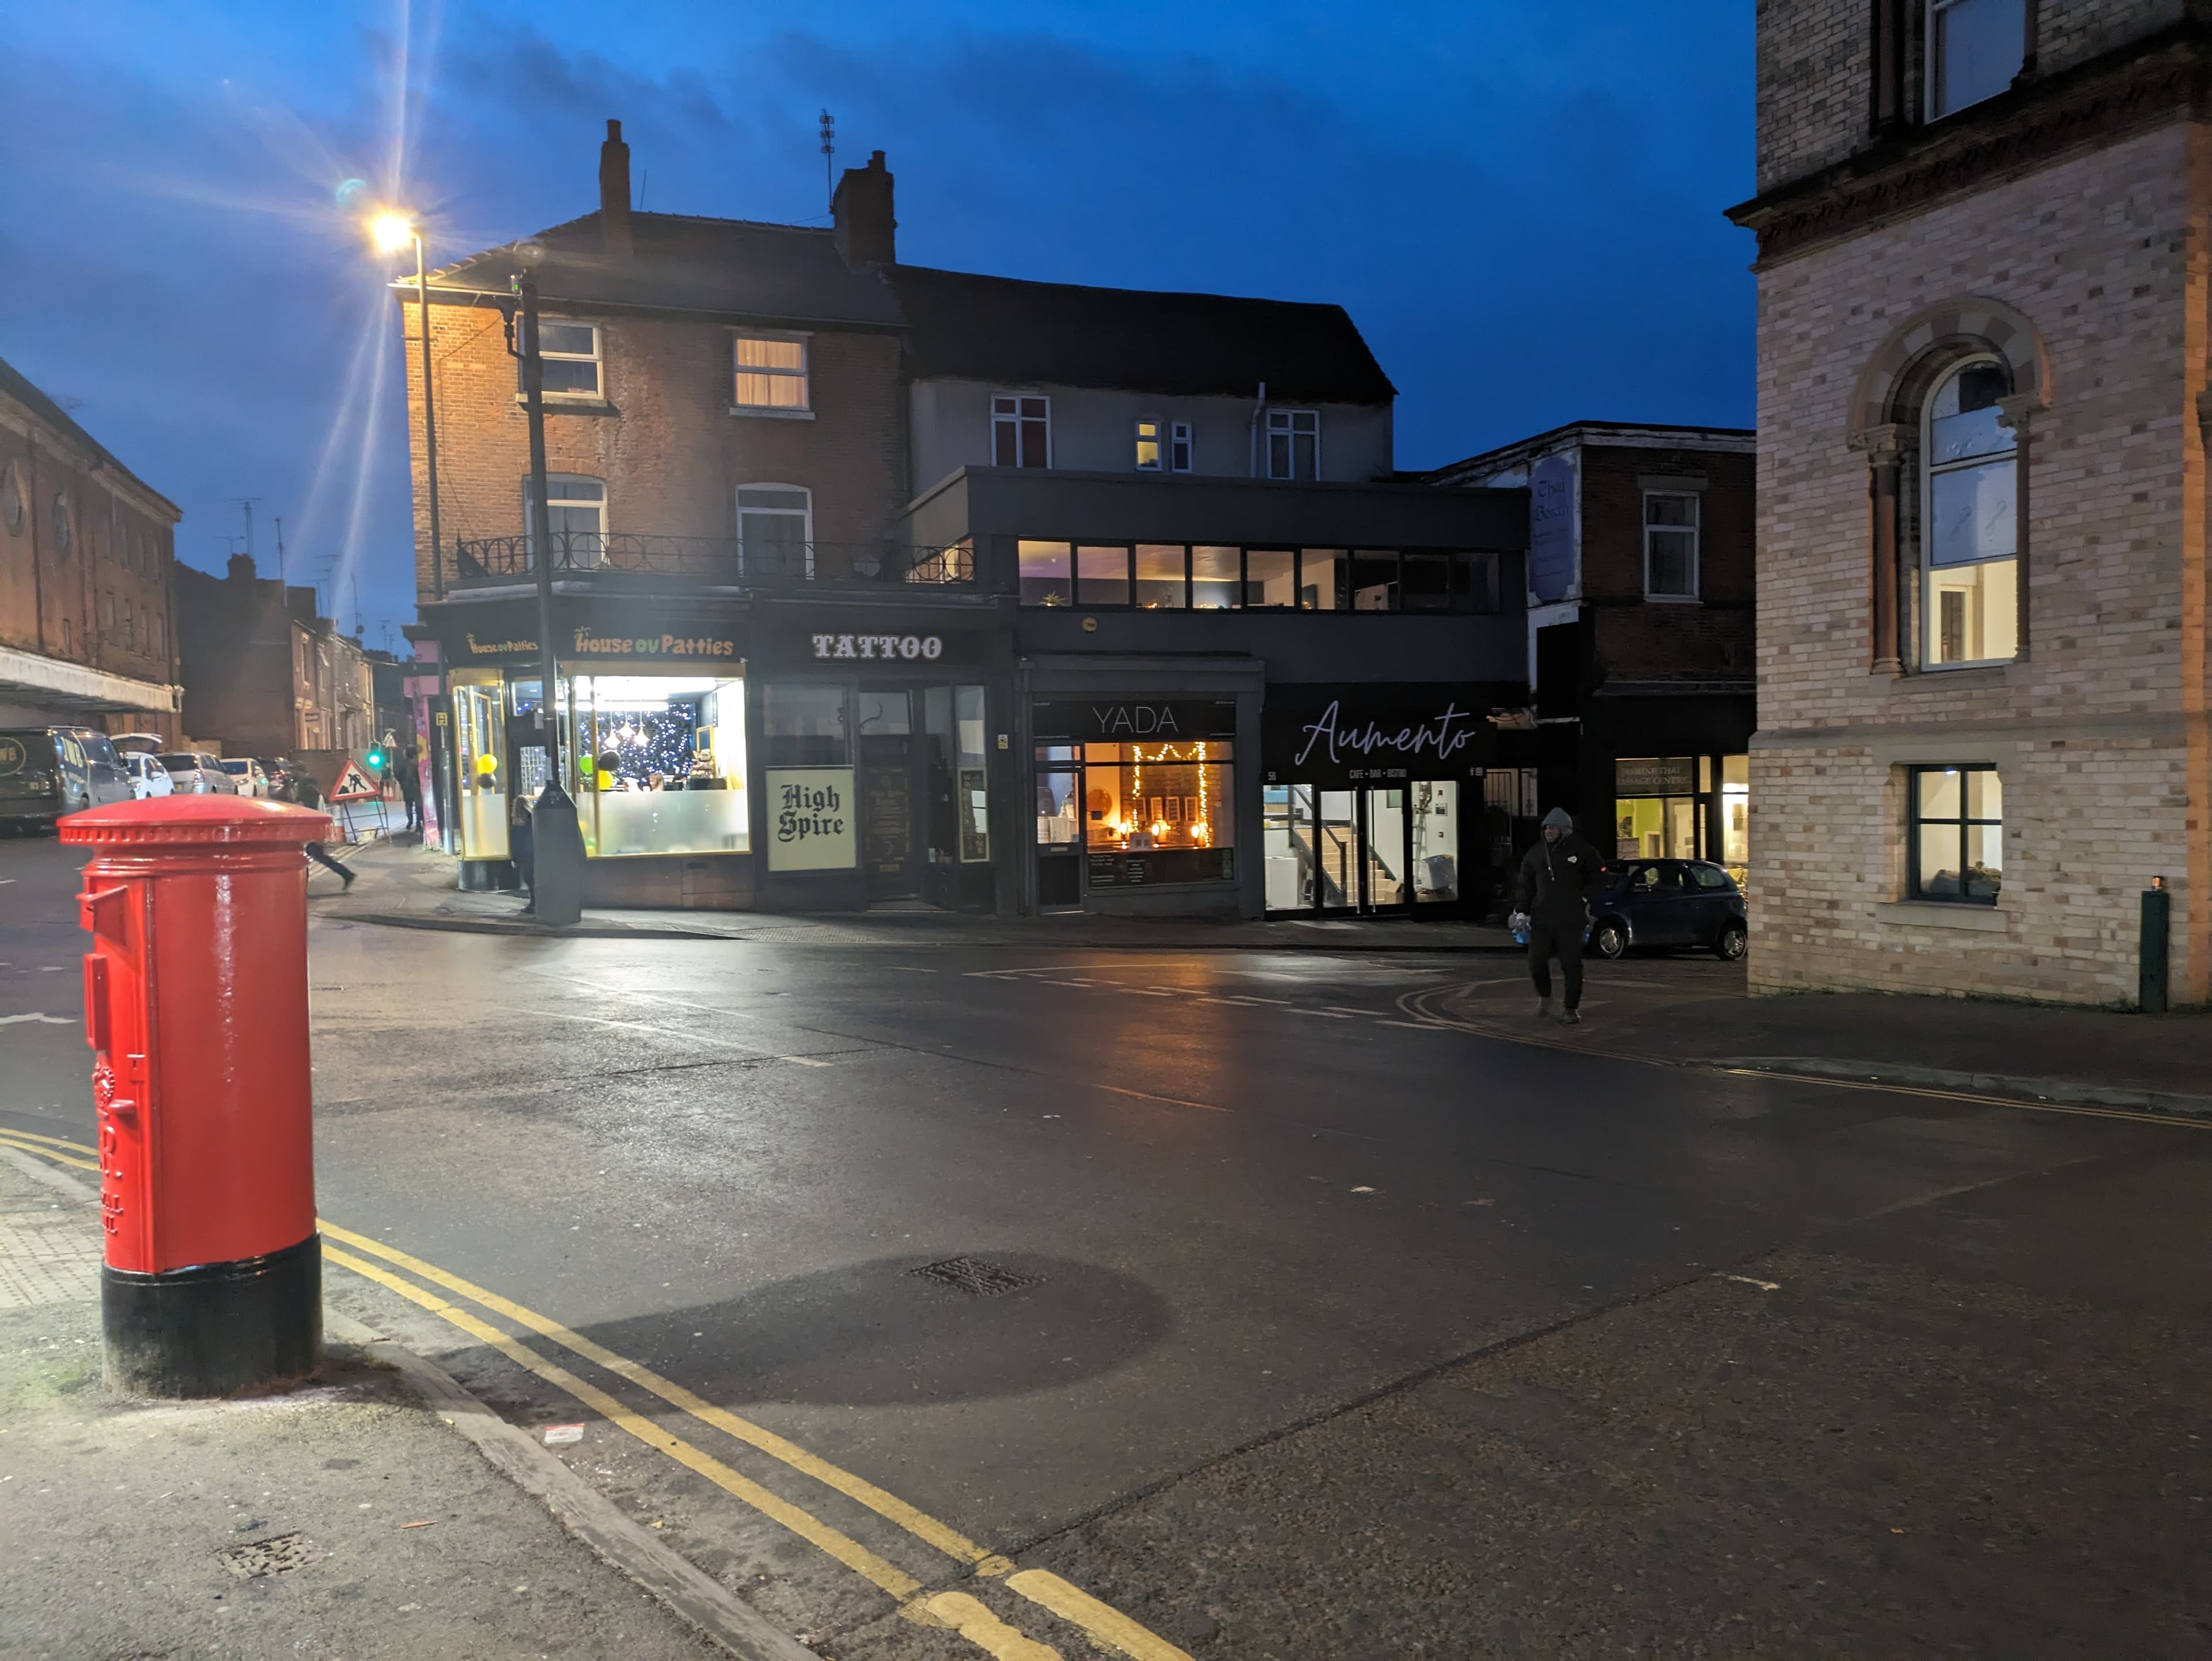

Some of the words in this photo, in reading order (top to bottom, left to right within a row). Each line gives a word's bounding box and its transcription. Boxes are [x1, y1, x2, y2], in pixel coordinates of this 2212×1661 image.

[574, 631, 633, 654] House
[635, 638, 659, 654] ov
[662, 634, 734, 655] Patties
[812, 634, 942, 659] TATTOO
[1092, 706, 1179, 733] YADA
[1294, 700, 1476, 766] Aumento
[781, 784, 840, 812] High
[778, 810, 845, 842] Spire
